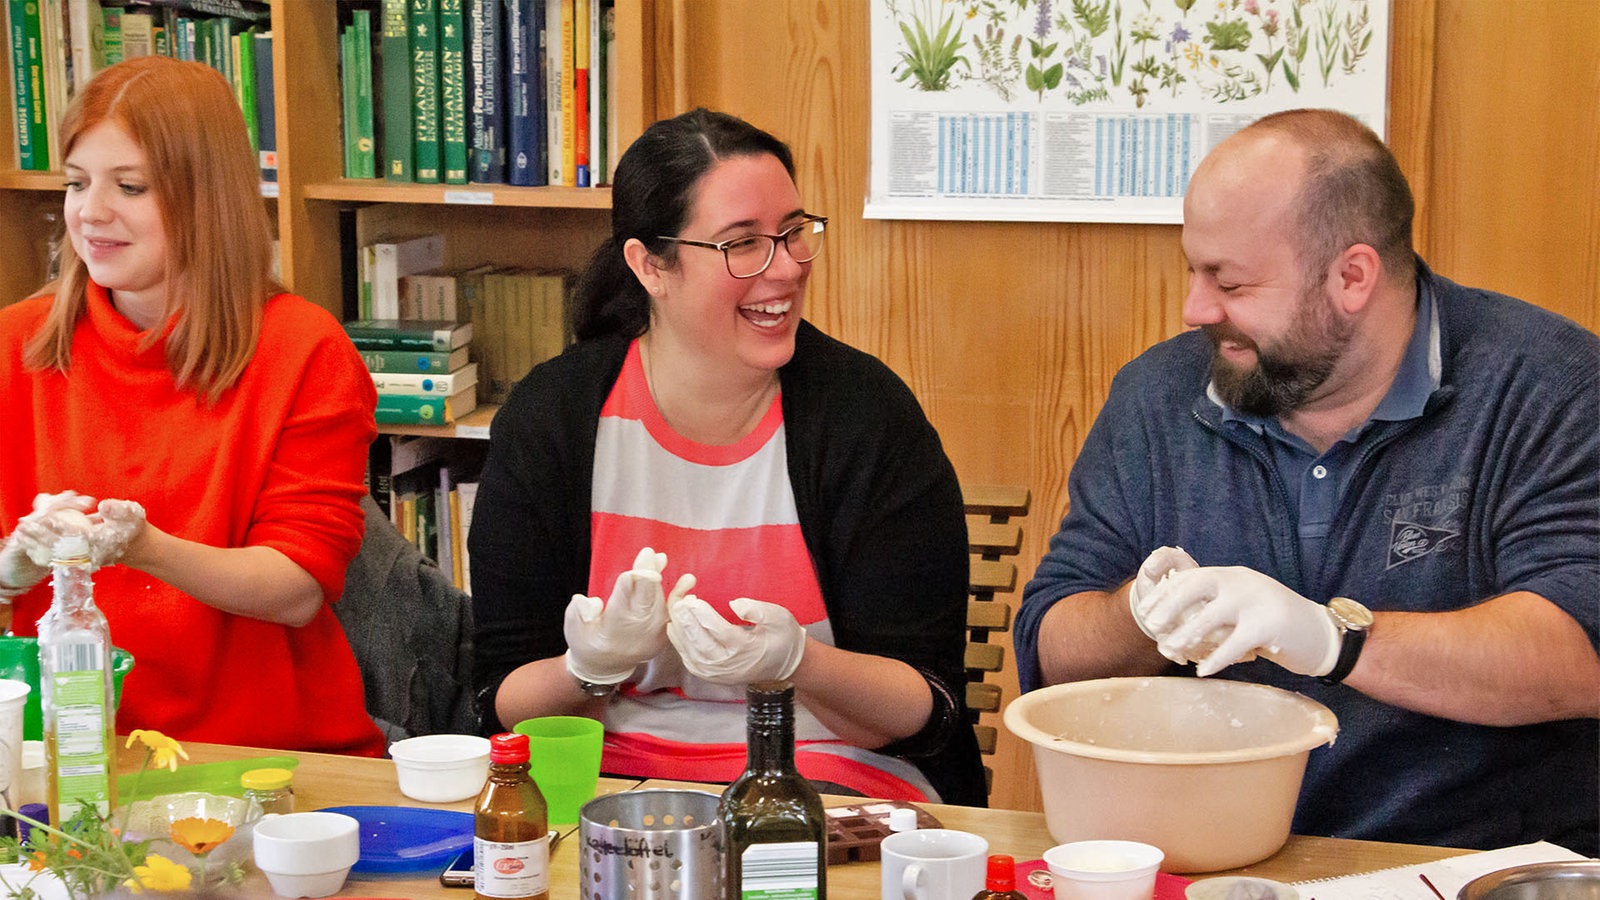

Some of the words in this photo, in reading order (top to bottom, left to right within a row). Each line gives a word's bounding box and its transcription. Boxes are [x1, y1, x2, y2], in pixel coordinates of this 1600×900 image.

[18, 68, 26, 96] Garten
[484, 101, 494, 115] der
[474, 115, 483, 129] der
[564, 112, 572, 149] BALKON
[473, 129, 483, 150] Atlas
